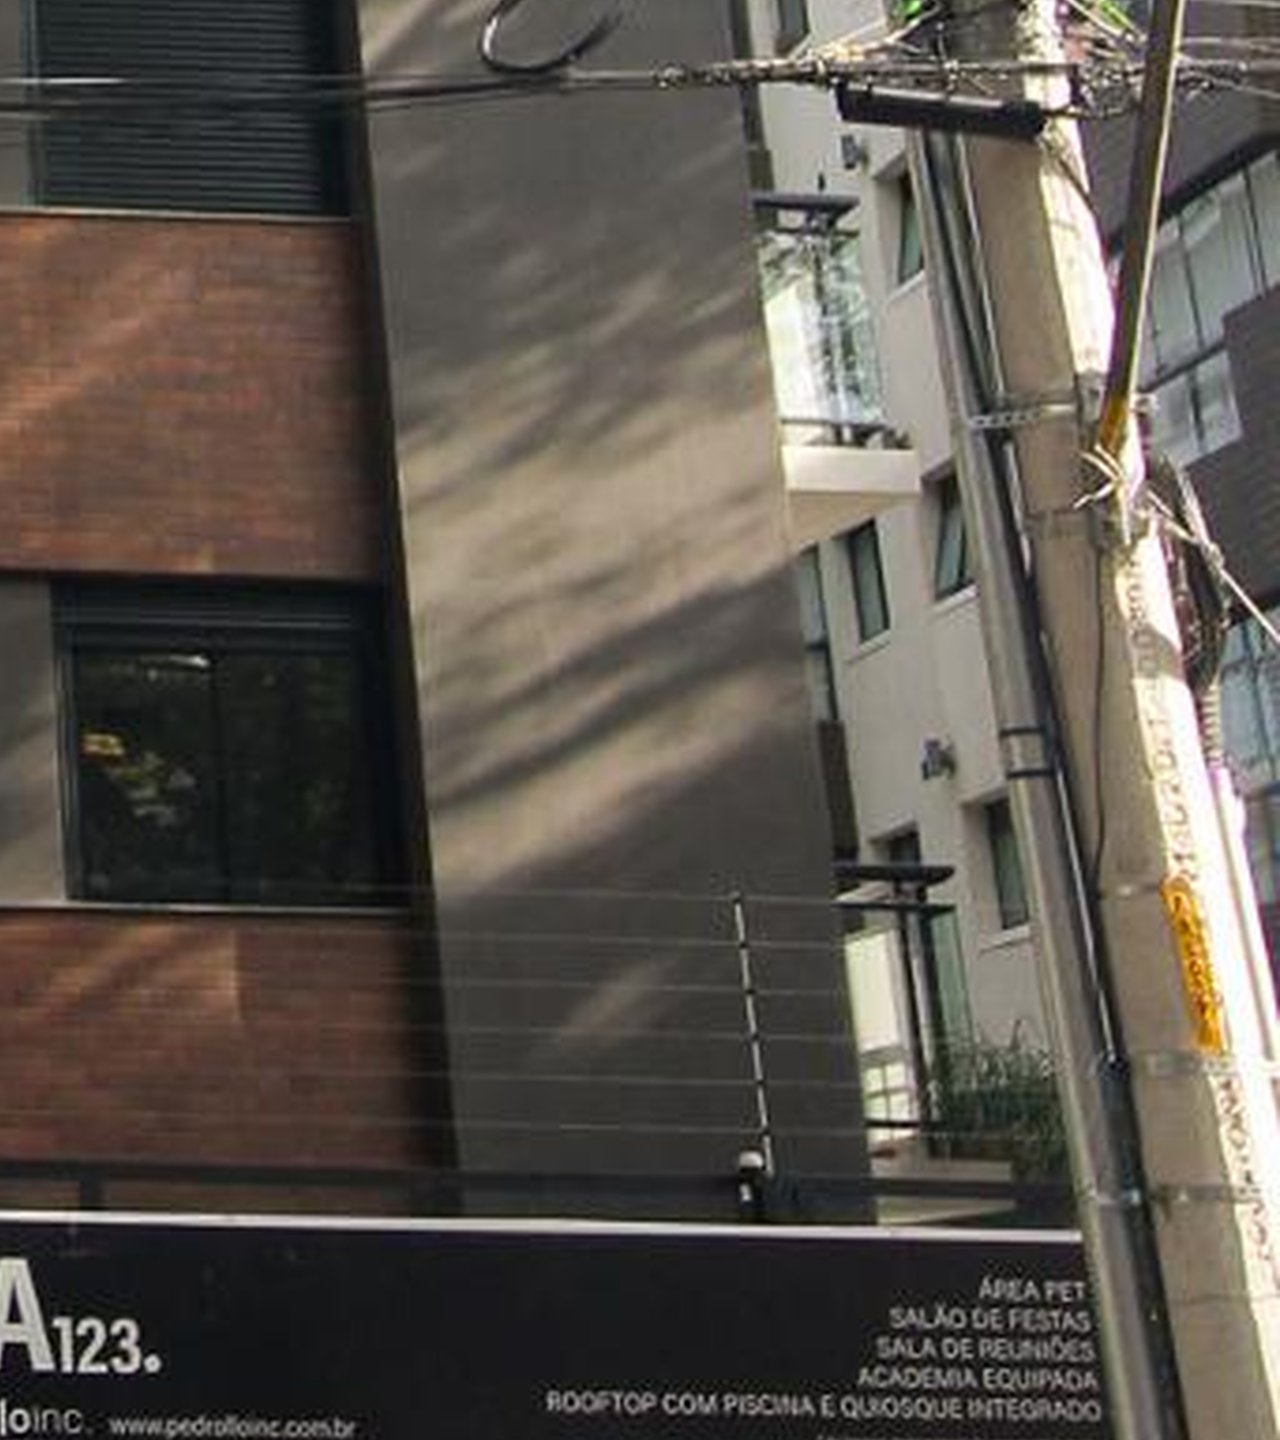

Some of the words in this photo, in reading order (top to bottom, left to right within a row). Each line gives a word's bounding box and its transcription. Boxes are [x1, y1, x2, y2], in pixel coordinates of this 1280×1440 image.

[978, 1275, 1040, 1300] ÁREA
[1045, 1281, 1085, 1302] PET
[889, 1303, 967, 1330] SALÃO
[971, 1307, 1003, 1330] DE
[1008, 1308, 1091, 1333] FESTAS
[876, 1336, 937, 1359] SALA
[941, 1337, 974, 1360] DE
[978, 1335, 1096, 1363] REUNIÕES
[857, 1365, 978, 1389] ACADEMIA
[982, 1367, 1099, 1392] EQUIPADA
[546, 1390, 657, 1415] ROOFTOP
[661, 1392, 718, 1415] COM
[722, 1393, 816, 1417] PISCINA
[820, 1395, 835, 1418] E
[840, 1395, 963, 1420] QUIOSQUE
[967, 1397, 1102, 1422] INTEGRADO
[109, 1413, 356, 1440] www.pedrolloinc.com.br
